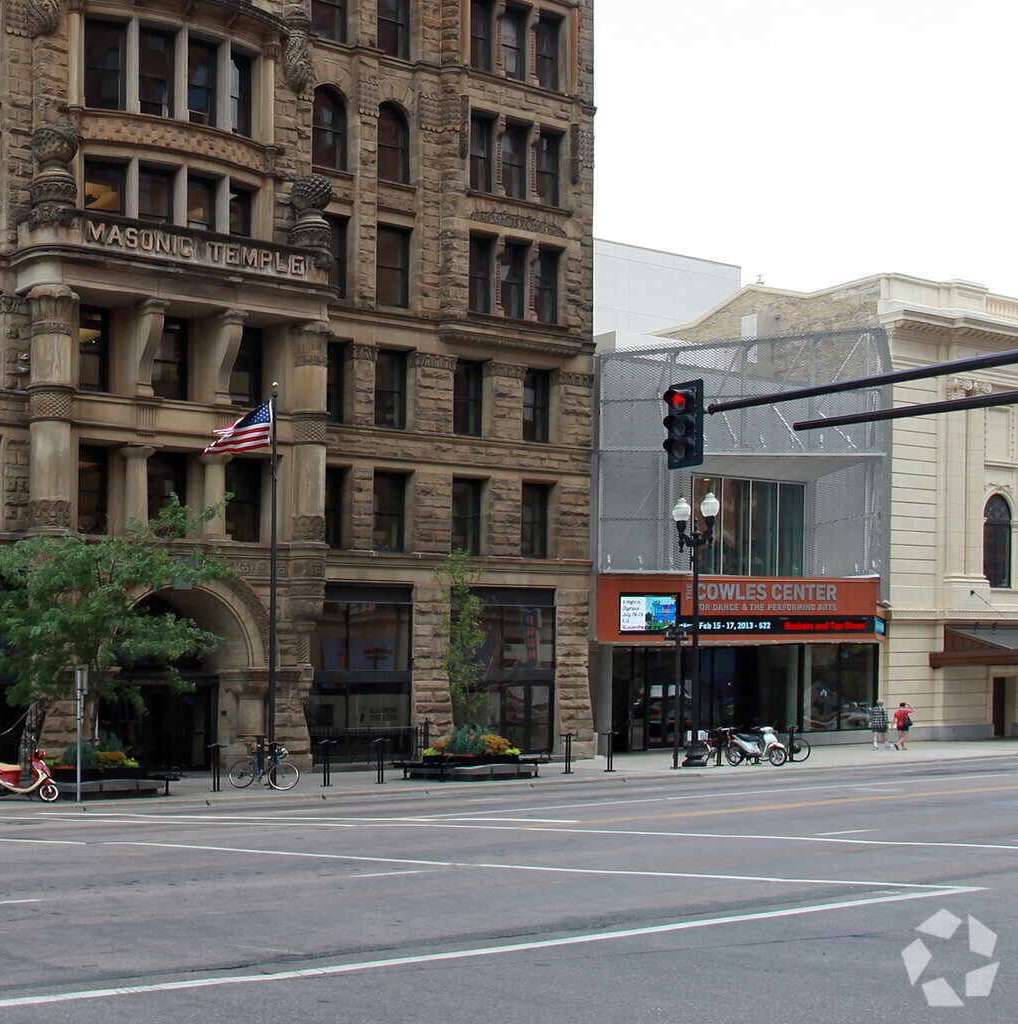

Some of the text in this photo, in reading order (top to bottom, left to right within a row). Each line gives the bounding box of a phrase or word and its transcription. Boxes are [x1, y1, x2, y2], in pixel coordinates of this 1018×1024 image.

[87, 220, 304, 275] MASONIC TEMPLE
[697, 583, 838, 601] COWLES CENTER
[698, 603, 711, 611] OR
[713, 603, 740, 611] DANCE
[750, 603, 765, 611] THE
[767, 603, 816, 611] PERFORMING
[698, 622, 712, 630] Feb
[726, 622, 737, 630] 17,
[737, 622, 754, 630] 2013
